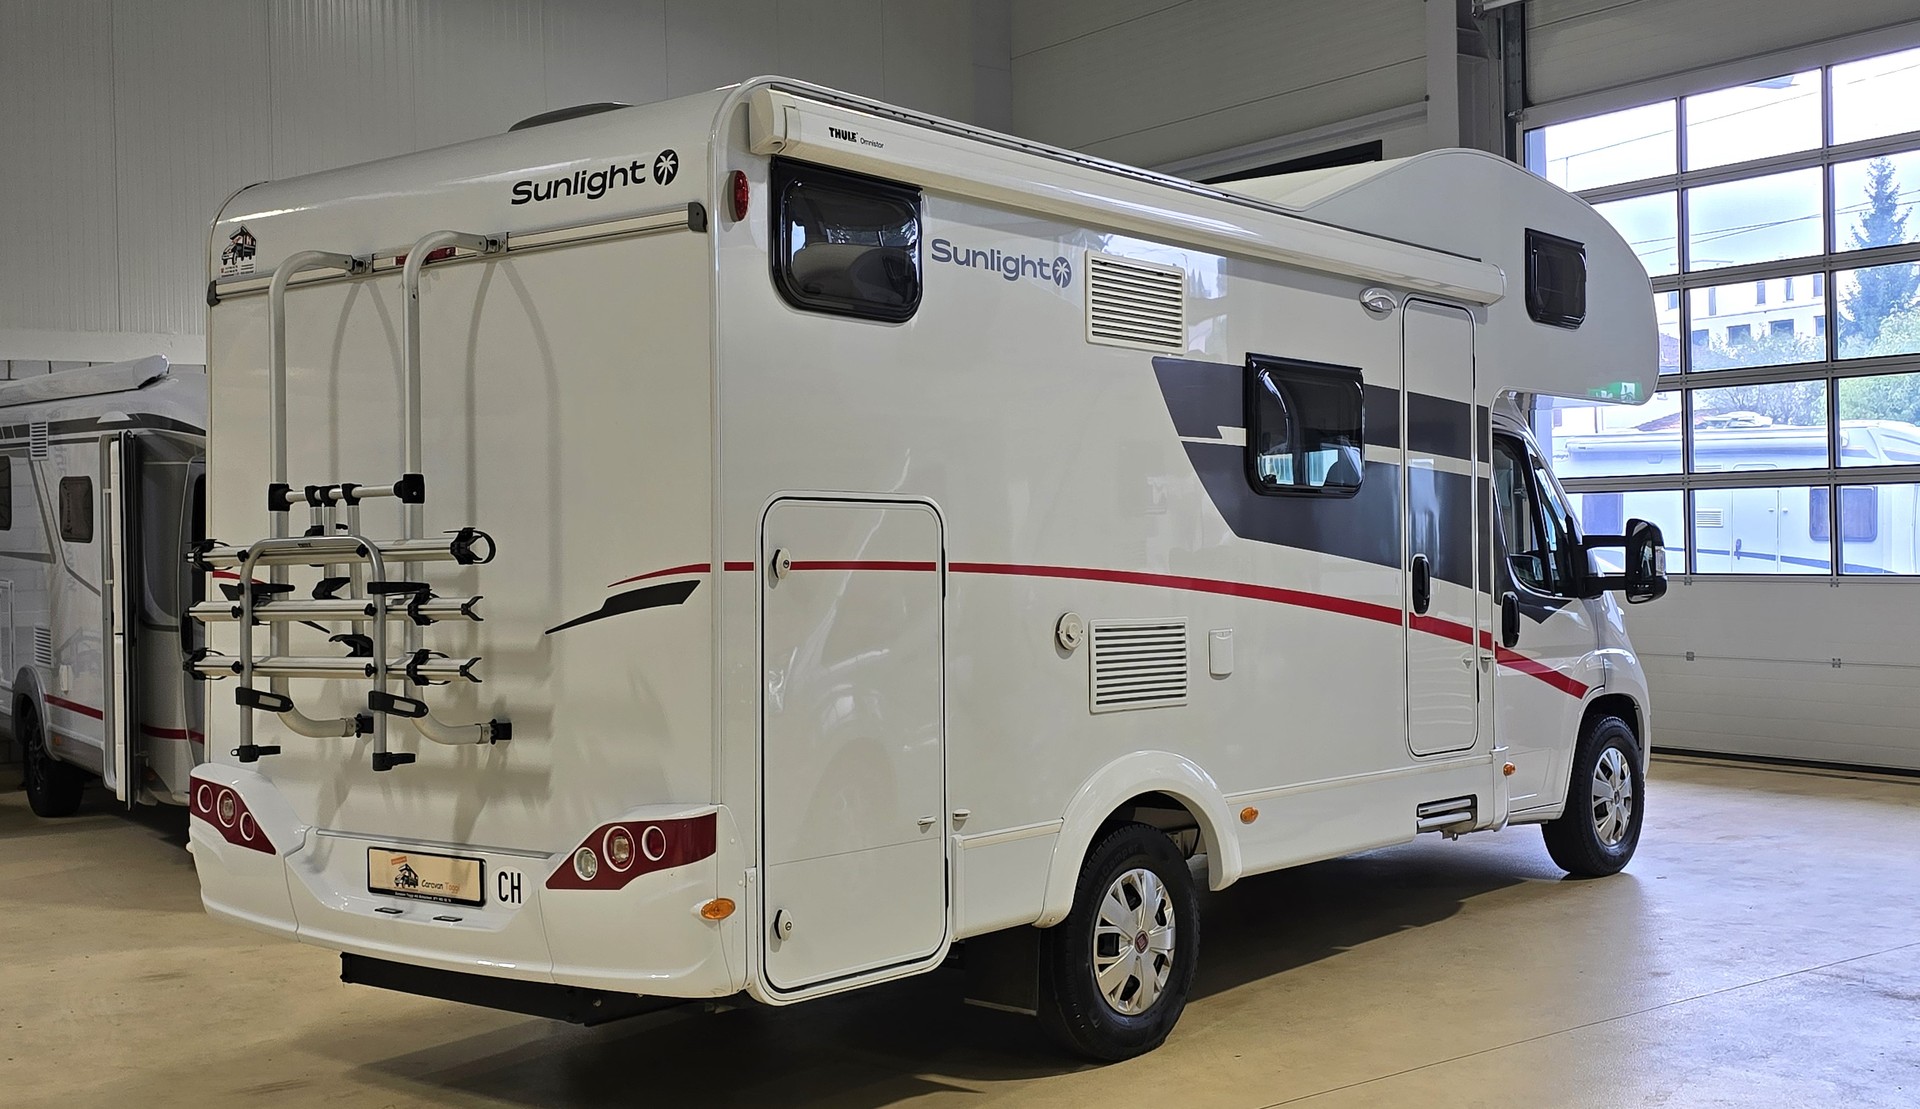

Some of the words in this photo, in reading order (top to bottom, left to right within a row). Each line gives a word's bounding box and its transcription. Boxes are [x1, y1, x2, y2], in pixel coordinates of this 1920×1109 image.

[828, 126, 858, 143] THULE
[860, 137, 884, 149] Omnistor
[511, 160, 646, 205] Sunlight
[931, 238, 1052, 281] Sunlight
[421, 879, 444, 890] Caravan
[498, 871, 521, 904] CH
